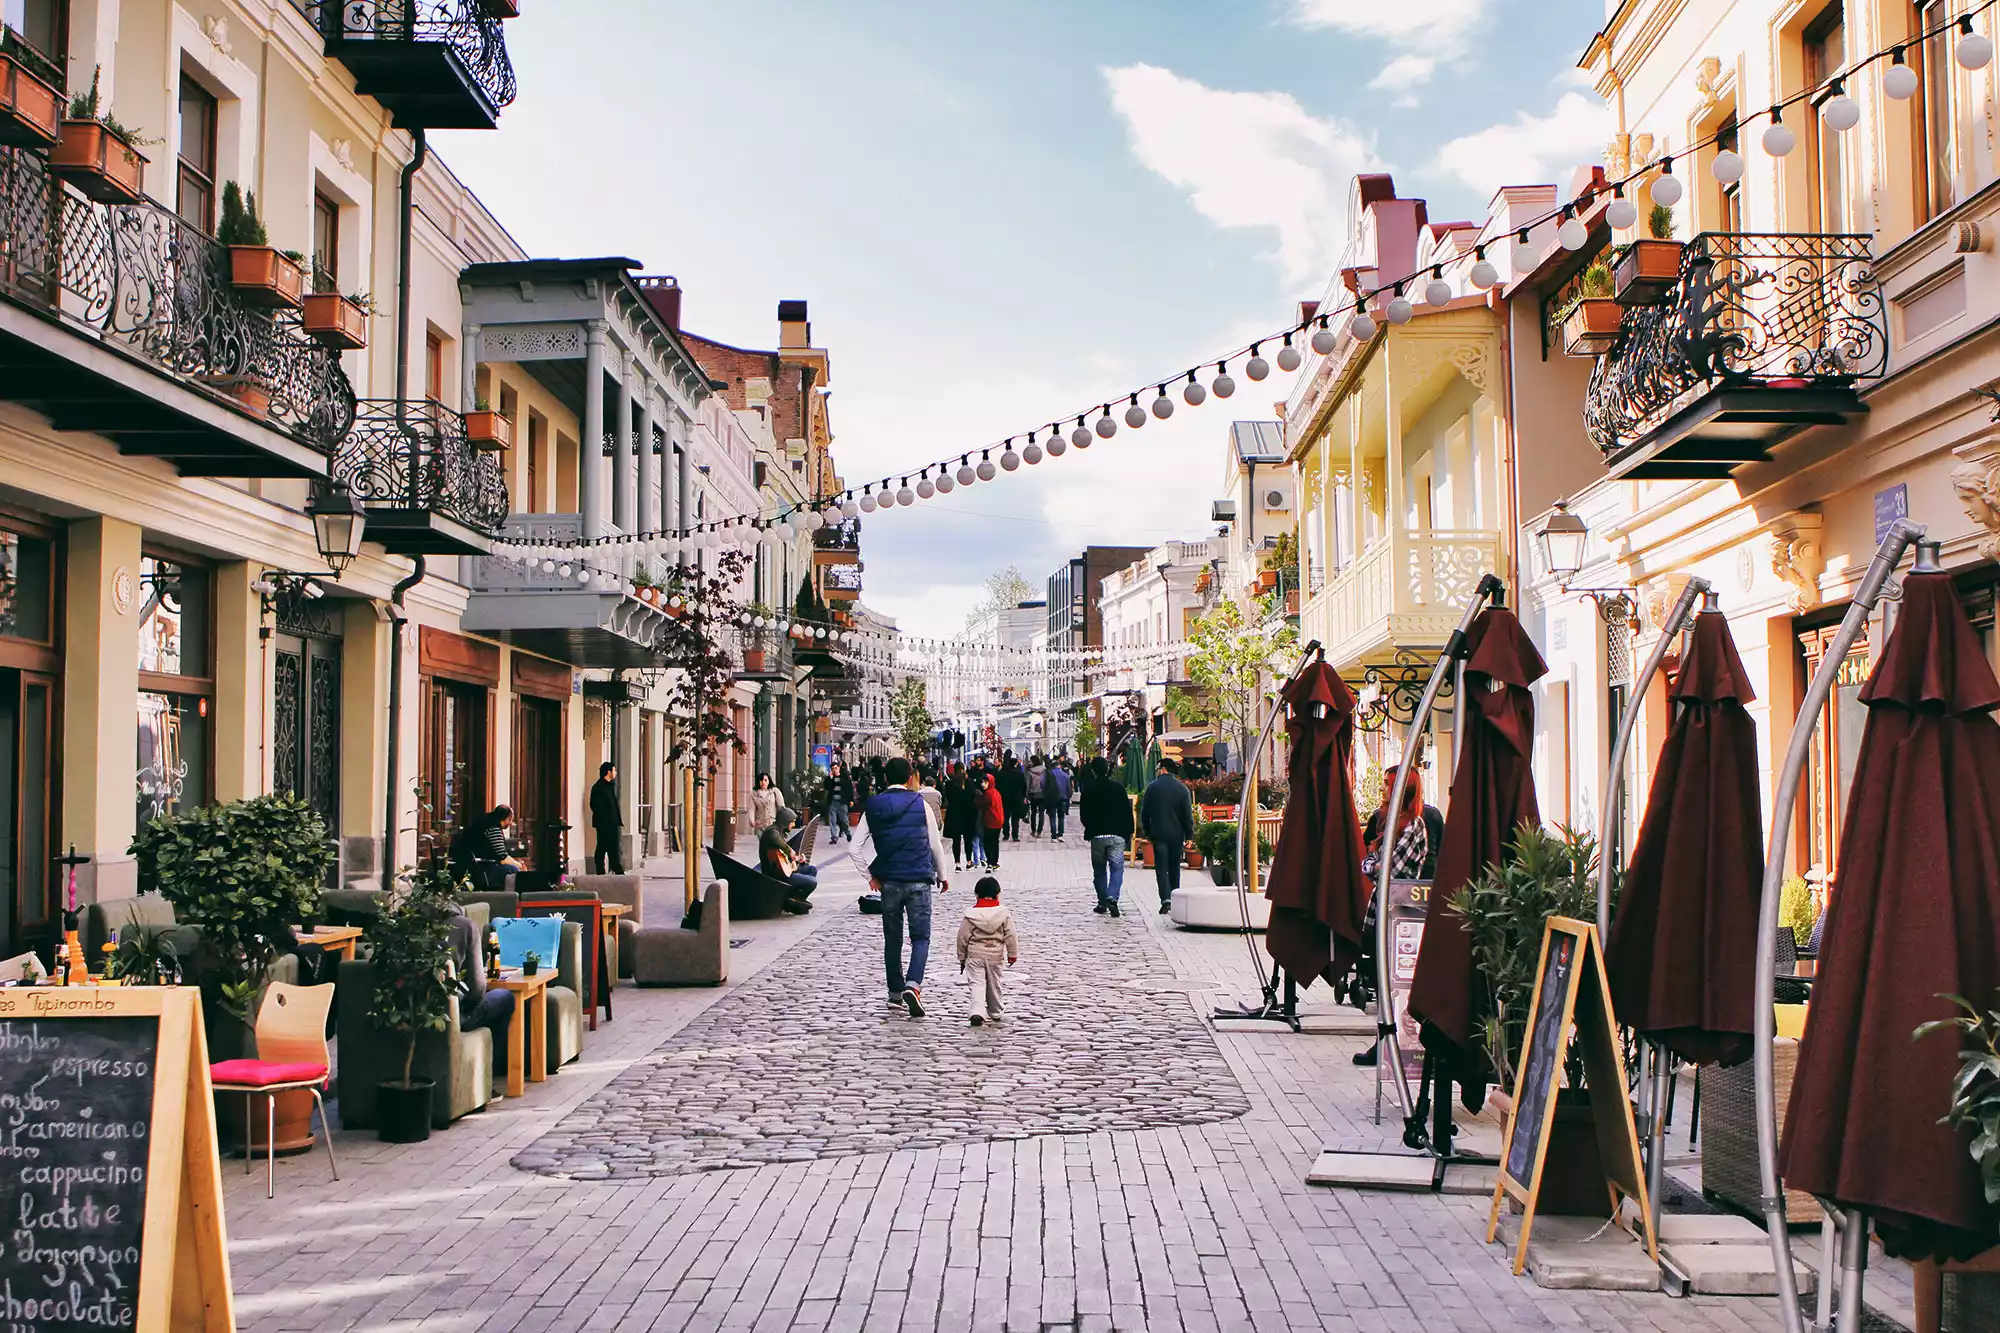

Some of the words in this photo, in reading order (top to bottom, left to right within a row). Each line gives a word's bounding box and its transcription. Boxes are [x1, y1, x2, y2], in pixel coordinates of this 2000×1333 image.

[1895, 491, 1905, 517] 33
[52, 1056, 148, 1087] espresso
[29, 1107, 146, 1139] americano
[20, 1151, 143, 1196] cappucino
[18, 1192, 122, 1230] latte
